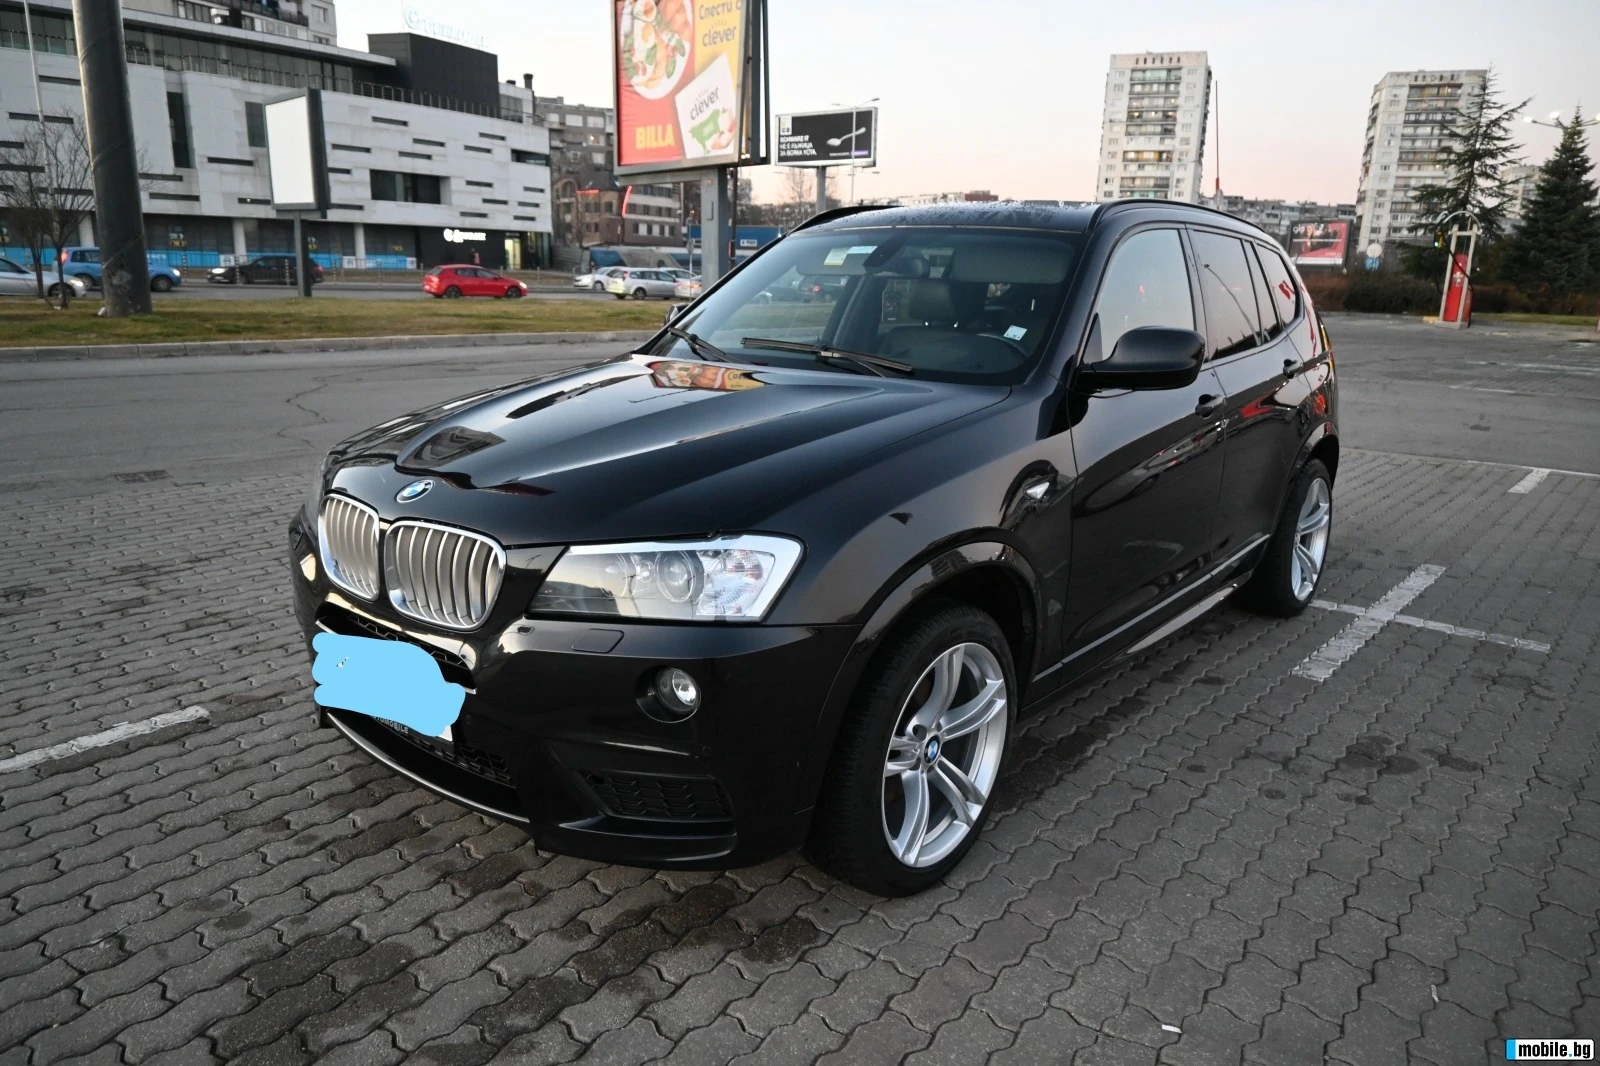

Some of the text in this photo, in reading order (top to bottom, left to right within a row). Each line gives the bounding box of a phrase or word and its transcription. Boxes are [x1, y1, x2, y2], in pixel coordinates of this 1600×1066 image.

[699, 1, 733, 20] Спести
[702, 26, 737, 47] clever
[690, 87, 720, 120] clever
[635, 123, 676, 150] BILLA
